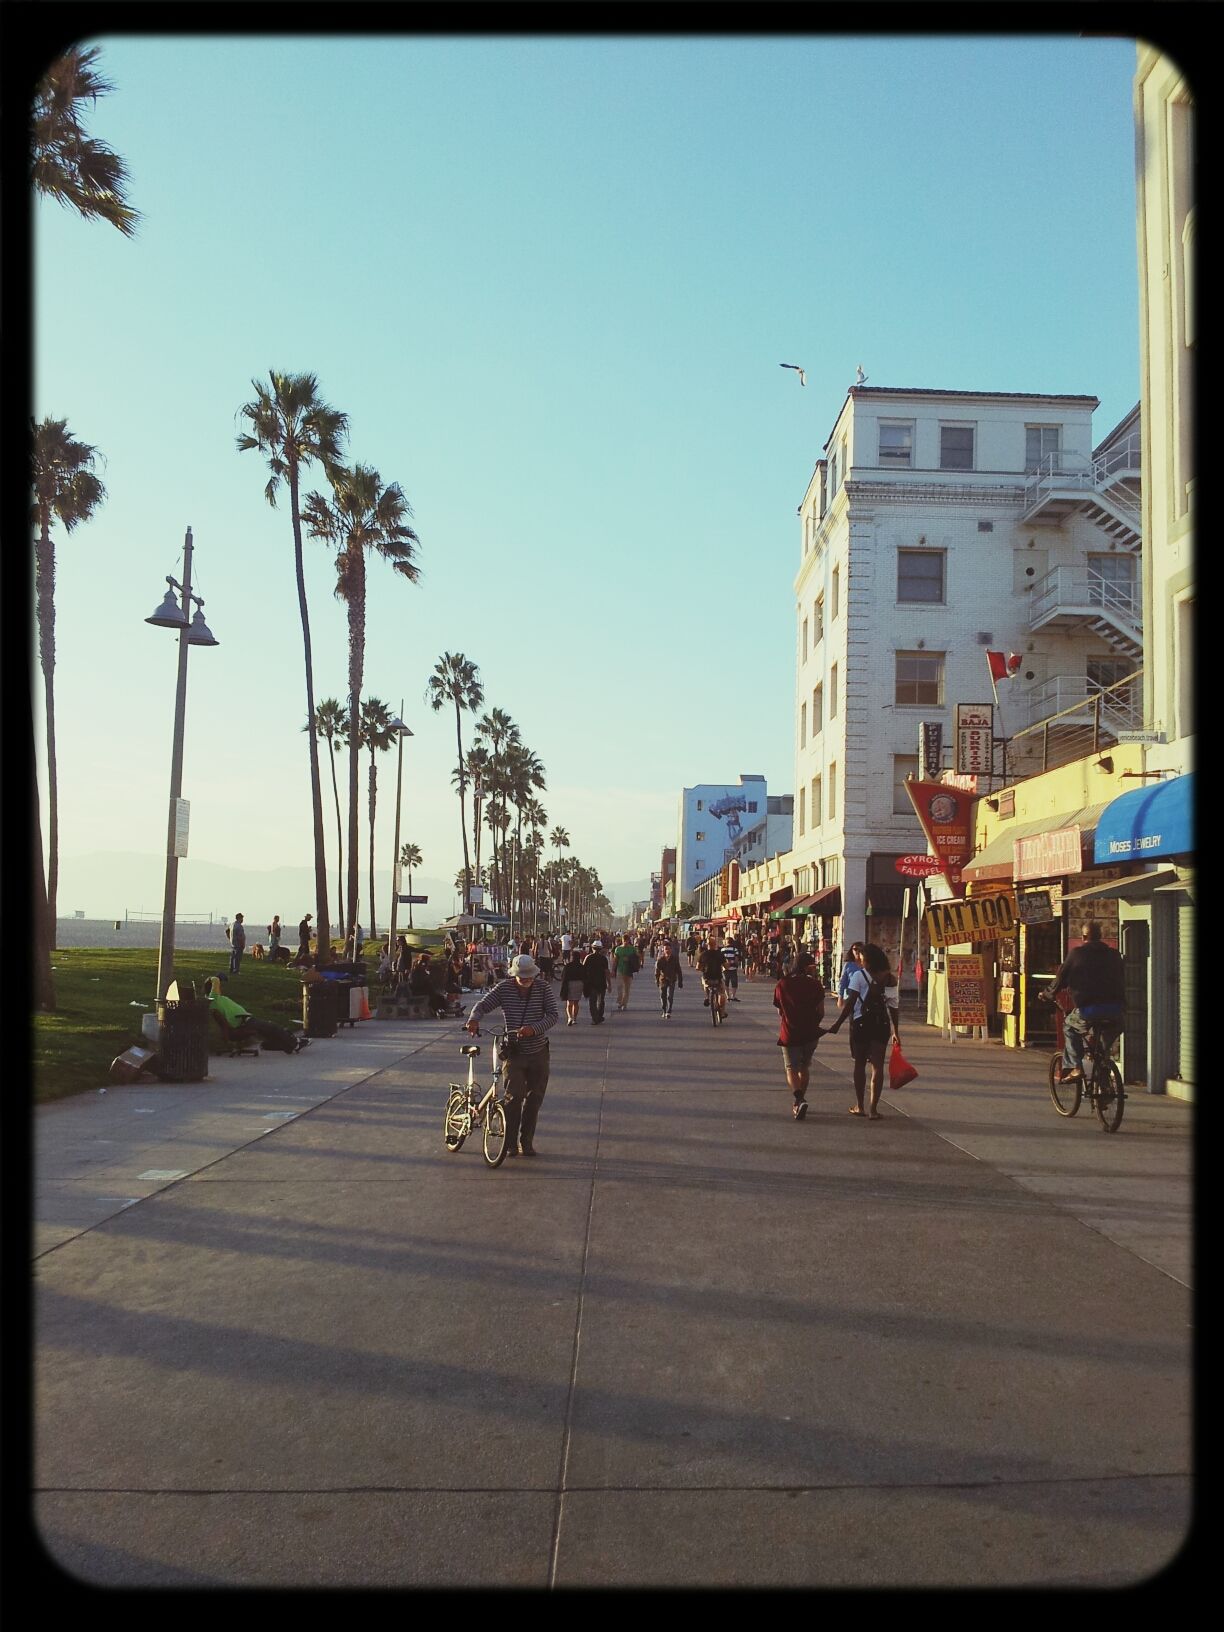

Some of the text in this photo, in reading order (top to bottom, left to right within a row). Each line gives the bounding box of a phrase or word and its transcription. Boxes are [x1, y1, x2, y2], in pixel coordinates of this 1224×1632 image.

[970, 731, 981, 771] BURRITOS
[936, 836, 966, 844] ICE CREAM
[1109, 835, 1162, 854] MOSES JEWELRY
[903, 855, 941, 866] GYROS
[901, 866, 942, 876] FALAFEL
[926, 894, 1014, 942] TATTOO
